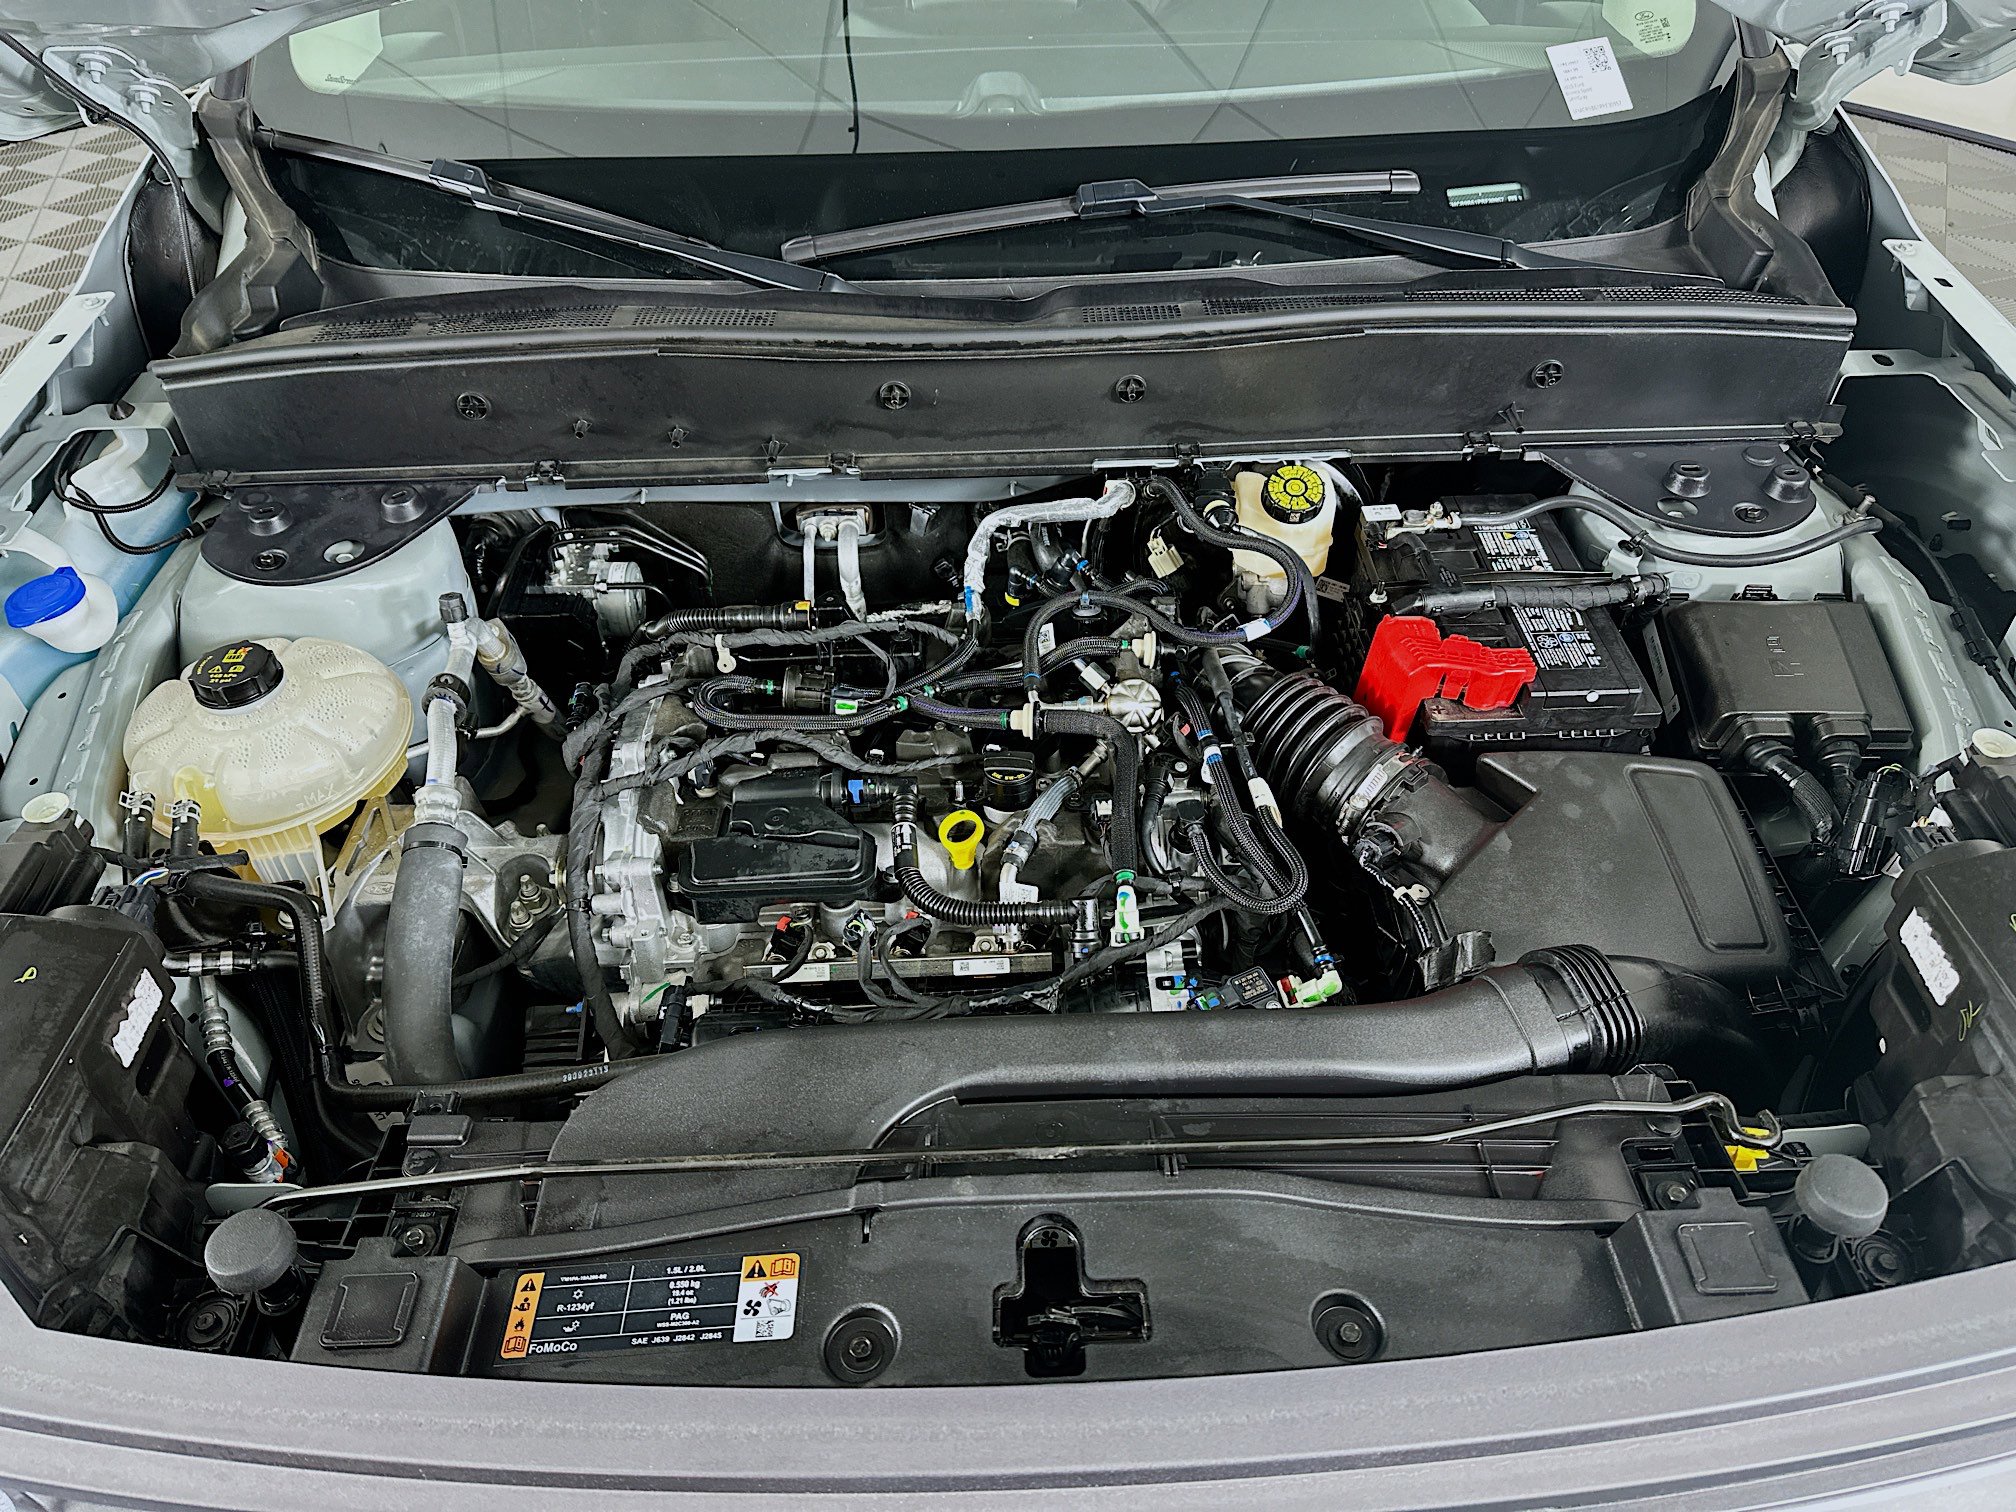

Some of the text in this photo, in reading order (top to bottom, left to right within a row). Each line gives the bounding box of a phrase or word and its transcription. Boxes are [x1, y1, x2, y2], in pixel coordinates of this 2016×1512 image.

[303, 783, 340, 806] MAX
[666, 1266, 683, 1274] 1.5L
[689, 1265, 706, 1273] 2.0L
[690, 1279, 700, 1289] kg
[556, 1302, 595, 1312] R-1234yf
[670, 1312, 690, 1320] PAG
[631, 1337, 648, 1345] SAE
[651, 1335, 670, 1344] J639
[673, 1334, 695, 1342] J2842
[528, 1341, 578, 1354] FoMoCo
